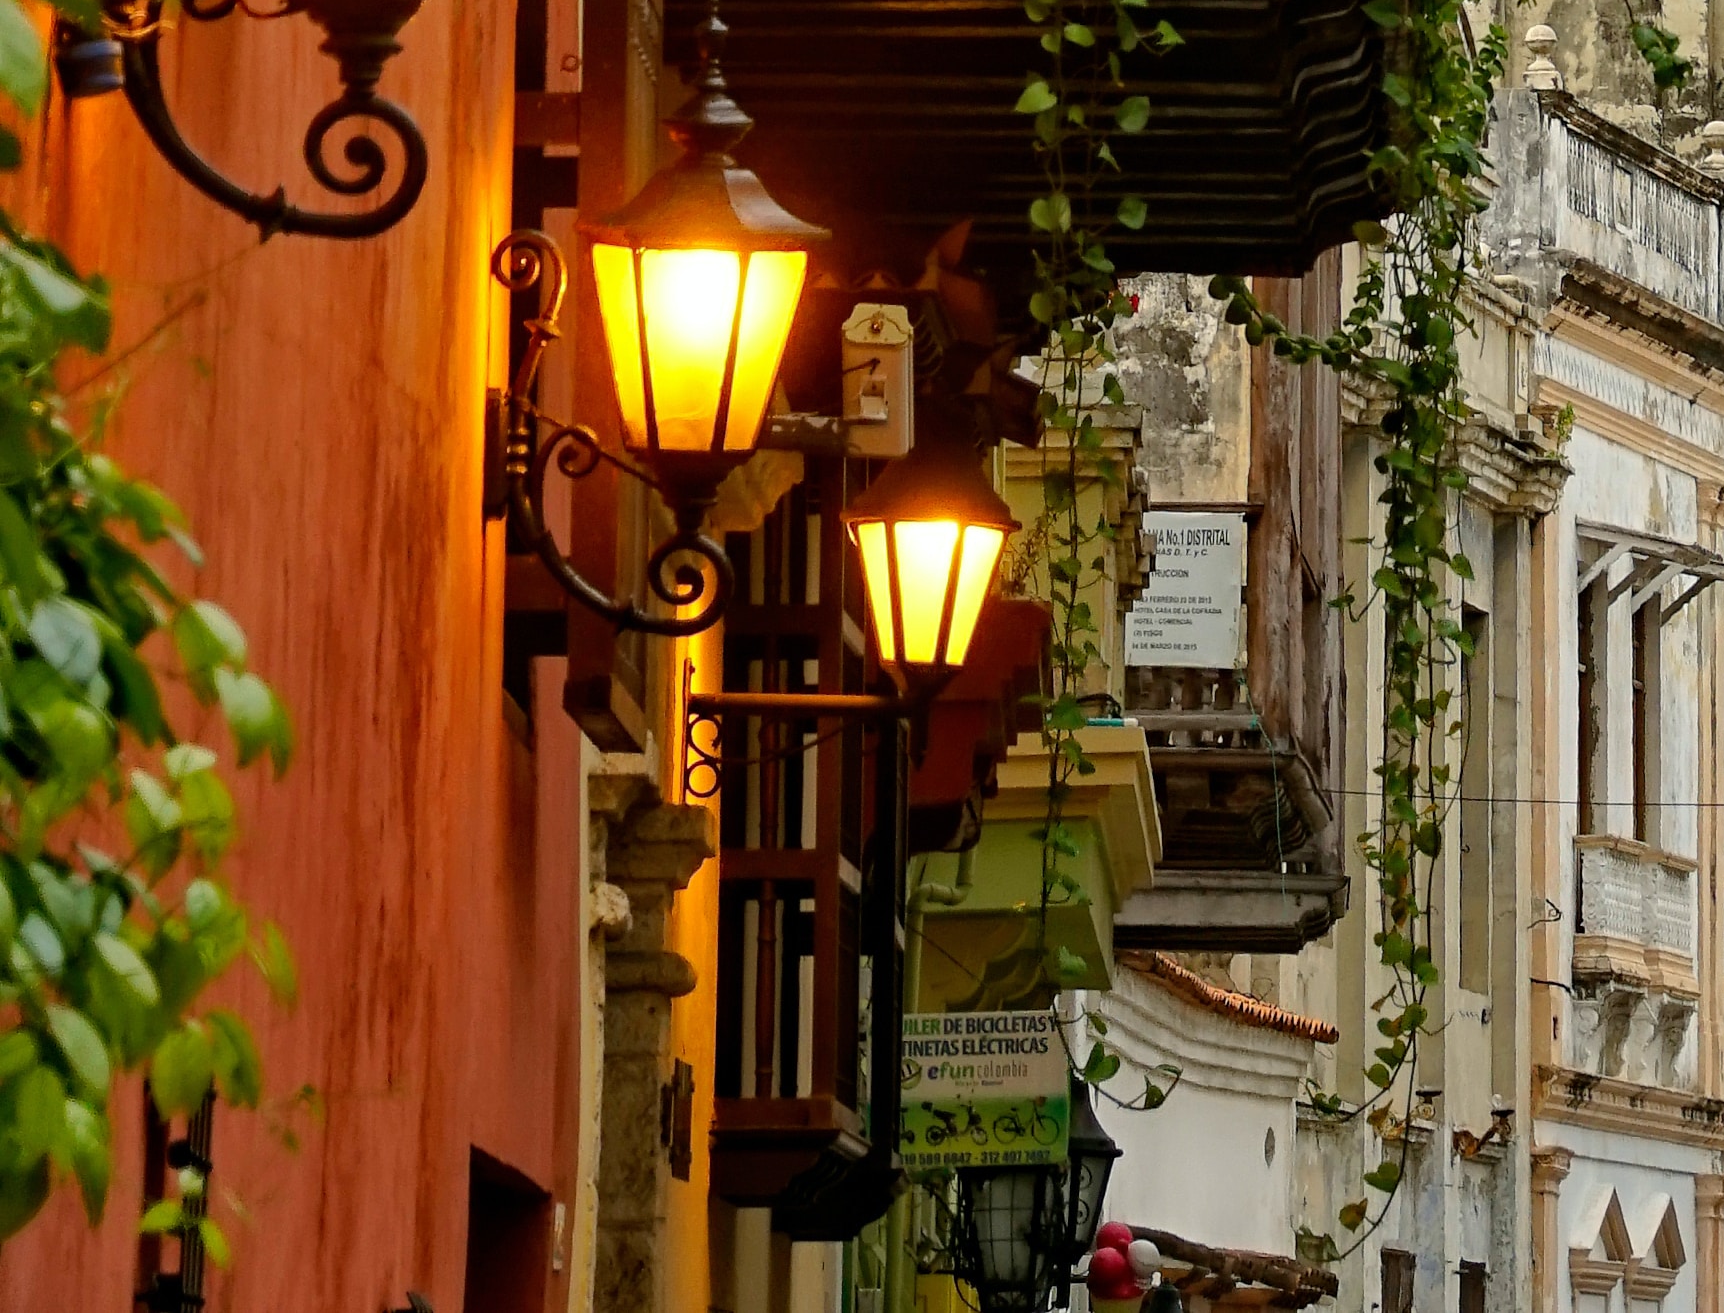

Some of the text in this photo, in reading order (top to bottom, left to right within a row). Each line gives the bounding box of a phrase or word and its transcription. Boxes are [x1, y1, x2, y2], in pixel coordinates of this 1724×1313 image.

[1166, 529, 1184, 546] No.1
[1187, 529, 1231, 546] DISTRITAL
[943, 1018, 963, 1035] DE
[966, 1016, 1046, 1035] BICICLETAS
[962, 1035, 1049, 1055] ELÉCTRICAS
